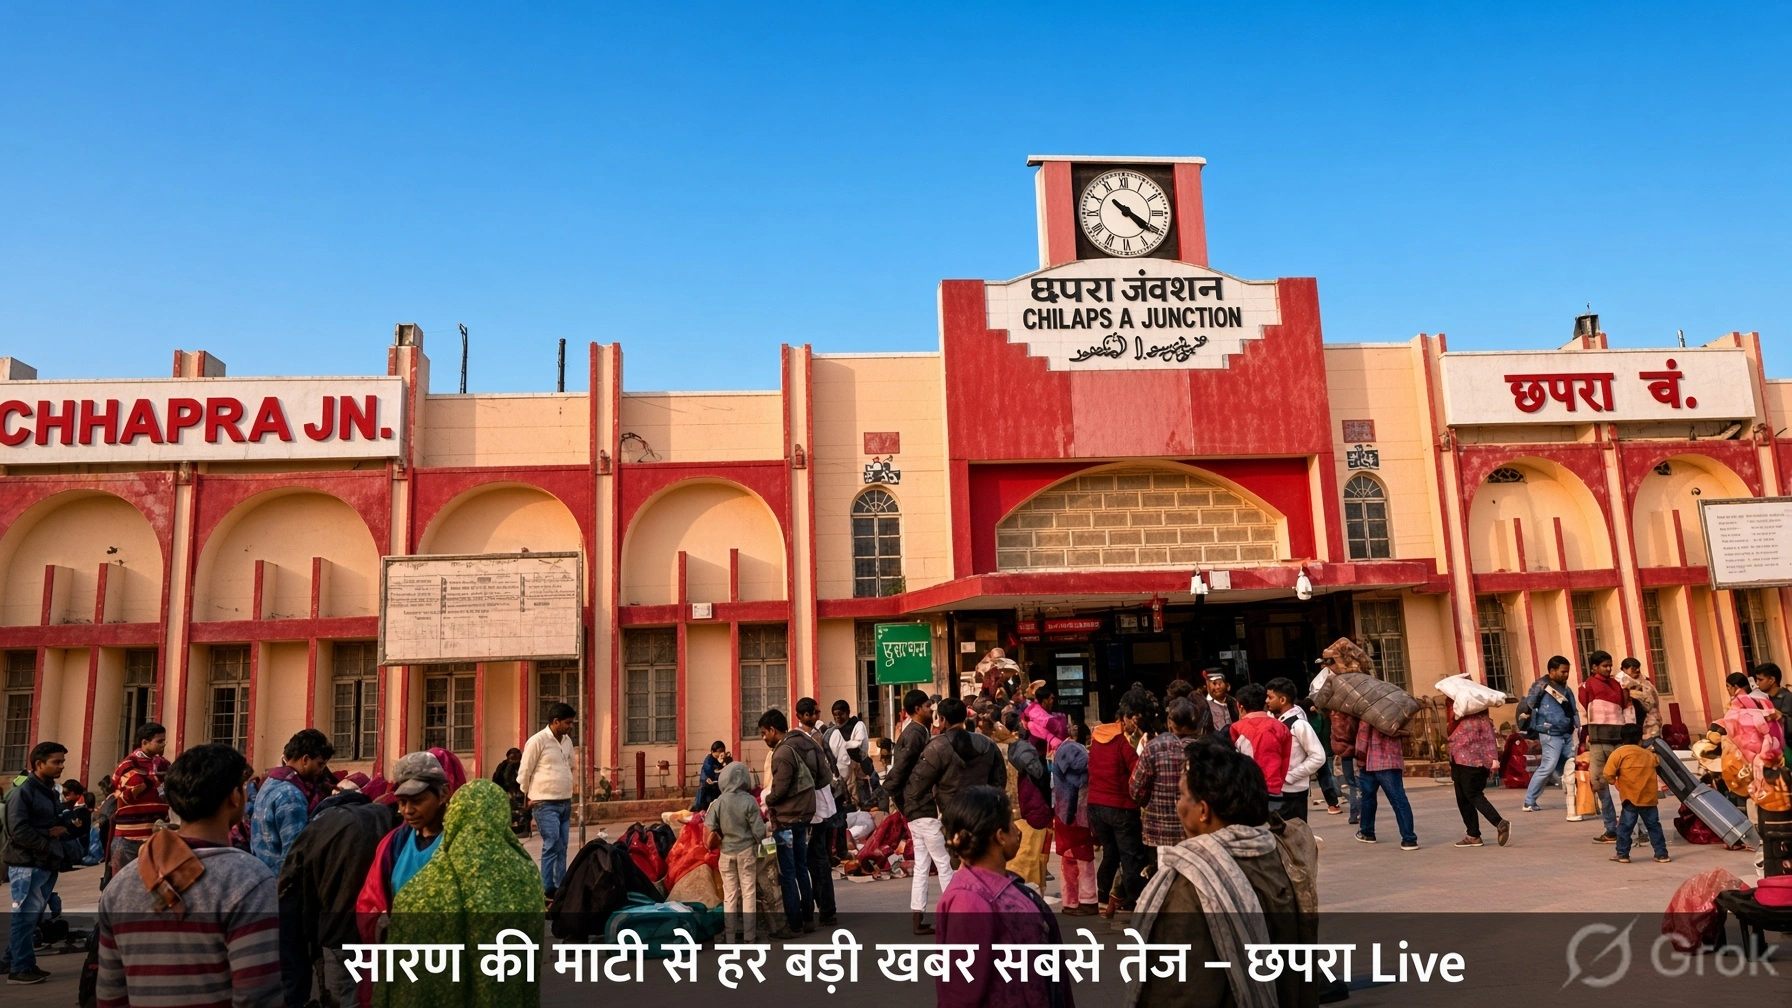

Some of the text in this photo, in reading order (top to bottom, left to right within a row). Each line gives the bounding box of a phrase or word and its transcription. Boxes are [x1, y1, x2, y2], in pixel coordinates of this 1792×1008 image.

[1023, 306, 1242, 330] CHILAPS A JUNCTION
[1504, 372, 1615, 413] छपरा
[0, 395, 392, 446] CHHAPRA JN.
